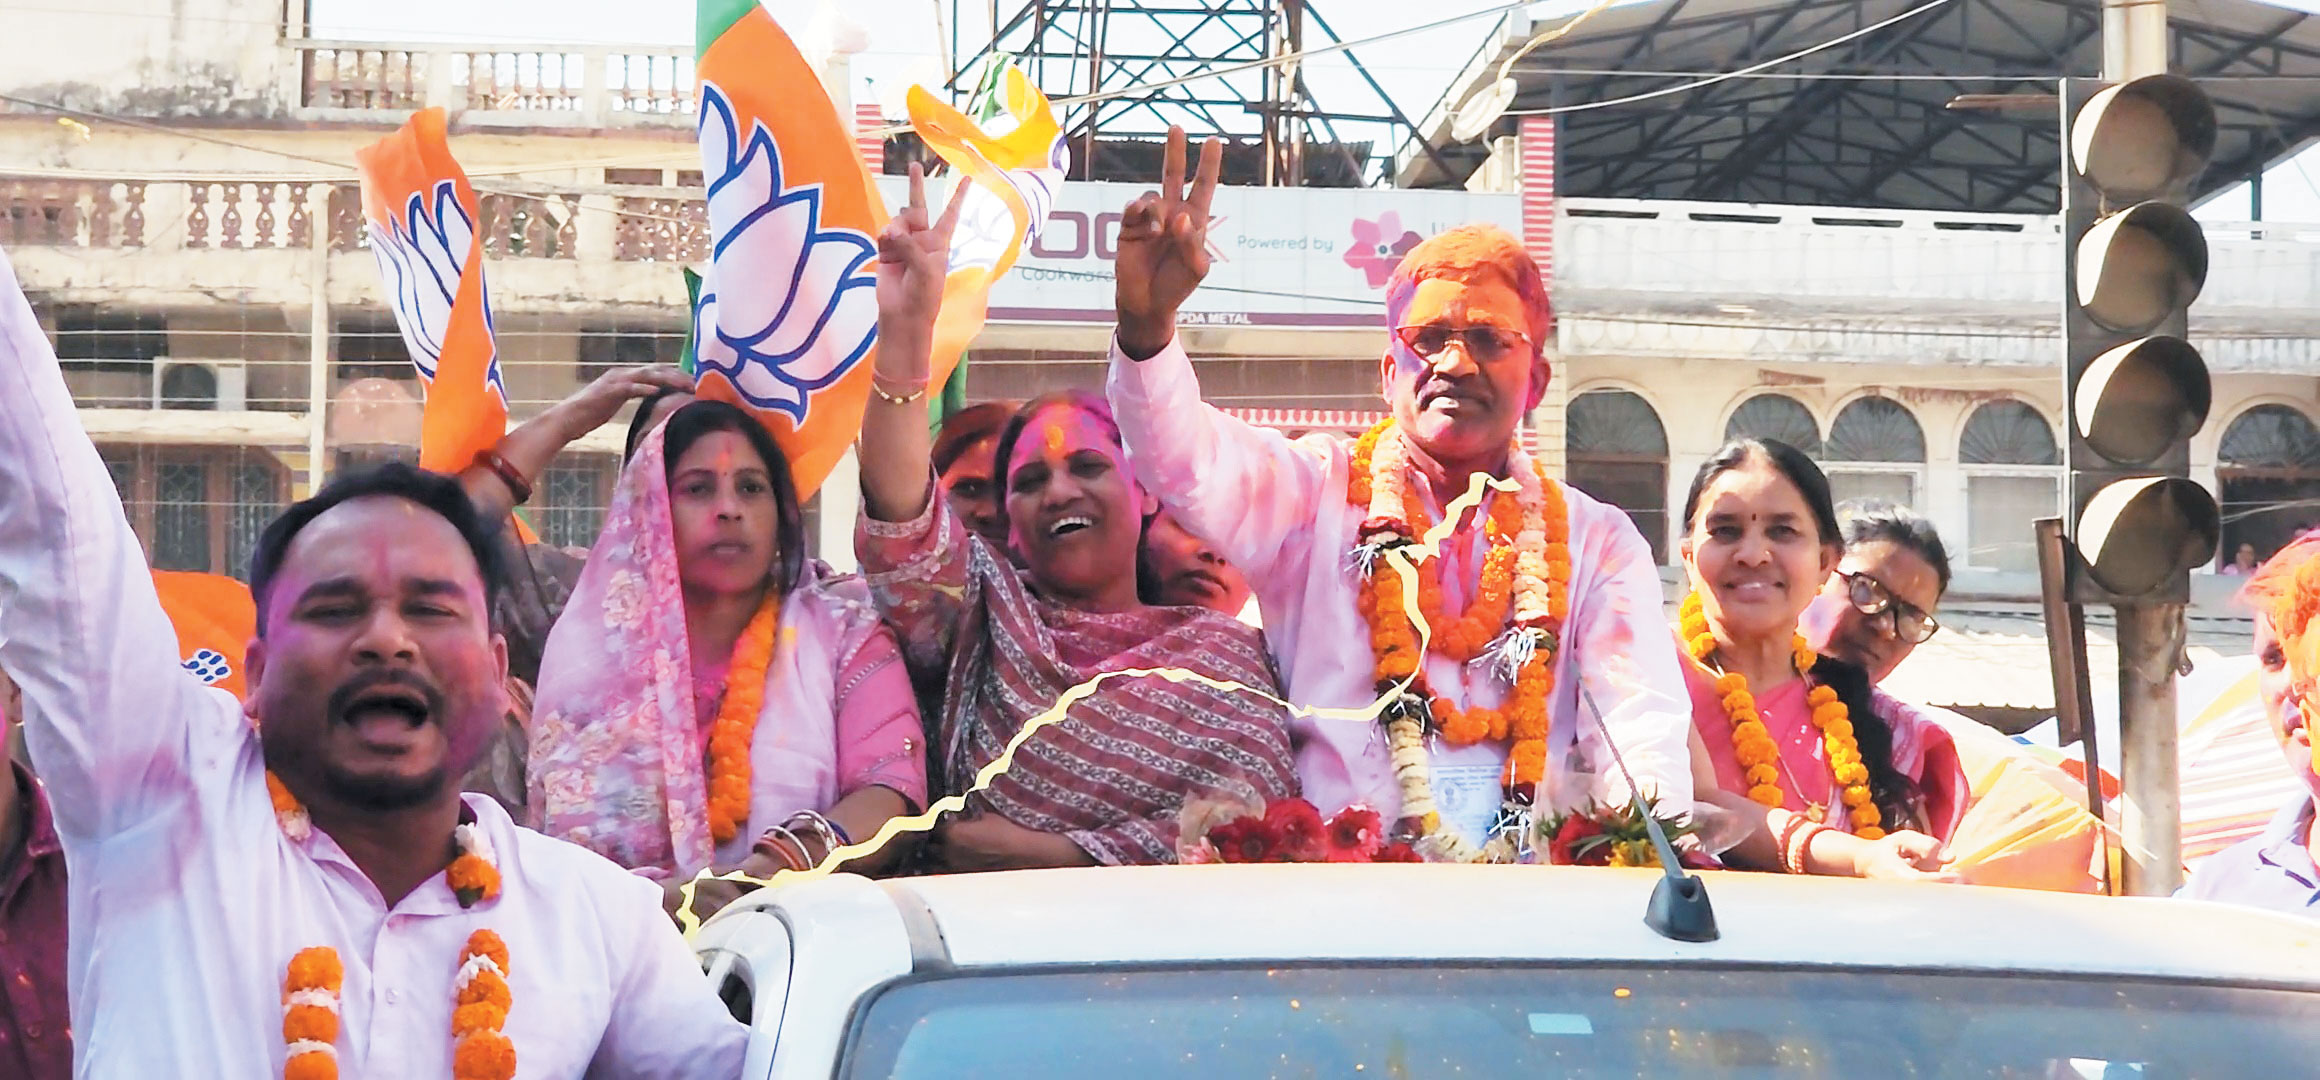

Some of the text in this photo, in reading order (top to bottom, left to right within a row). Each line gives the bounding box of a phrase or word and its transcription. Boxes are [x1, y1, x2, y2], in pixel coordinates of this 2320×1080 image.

[1237, 234, 1334, 254] Powered by
[1021, 262, 1114, 283] Cookware
[1207, 313, 1252, 325] METAL
